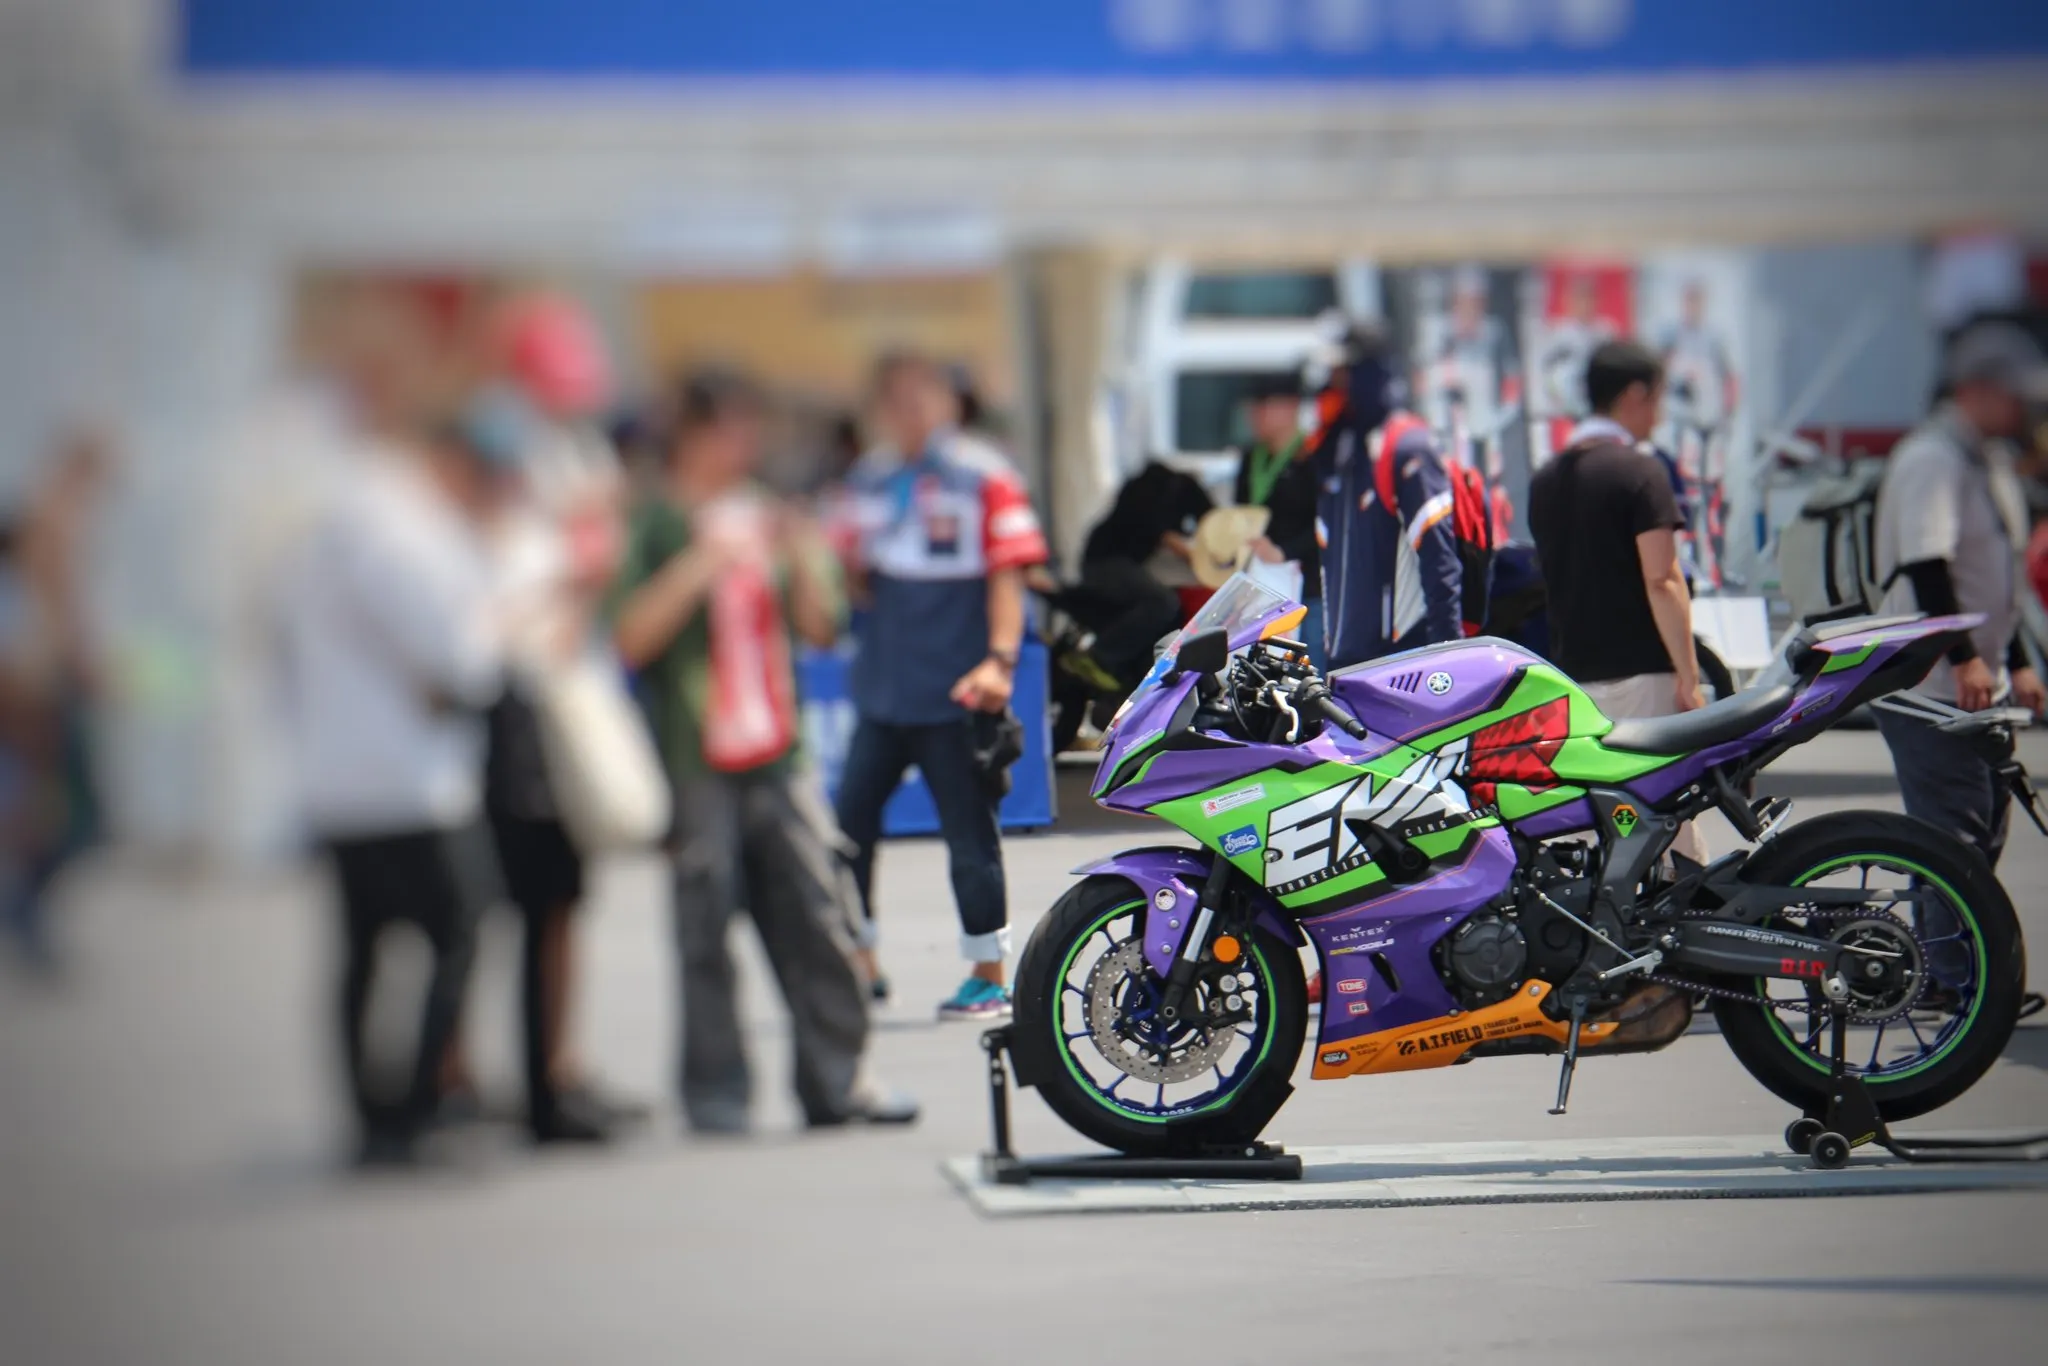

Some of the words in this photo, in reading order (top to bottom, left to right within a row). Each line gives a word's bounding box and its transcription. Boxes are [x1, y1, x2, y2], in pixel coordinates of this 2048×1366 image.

[1331, 926, 1385, 942] KENTEX
[1340, 981, 1366, 991] TONE
[1419, 1025, 1483, 1051] A.T.FIELD
